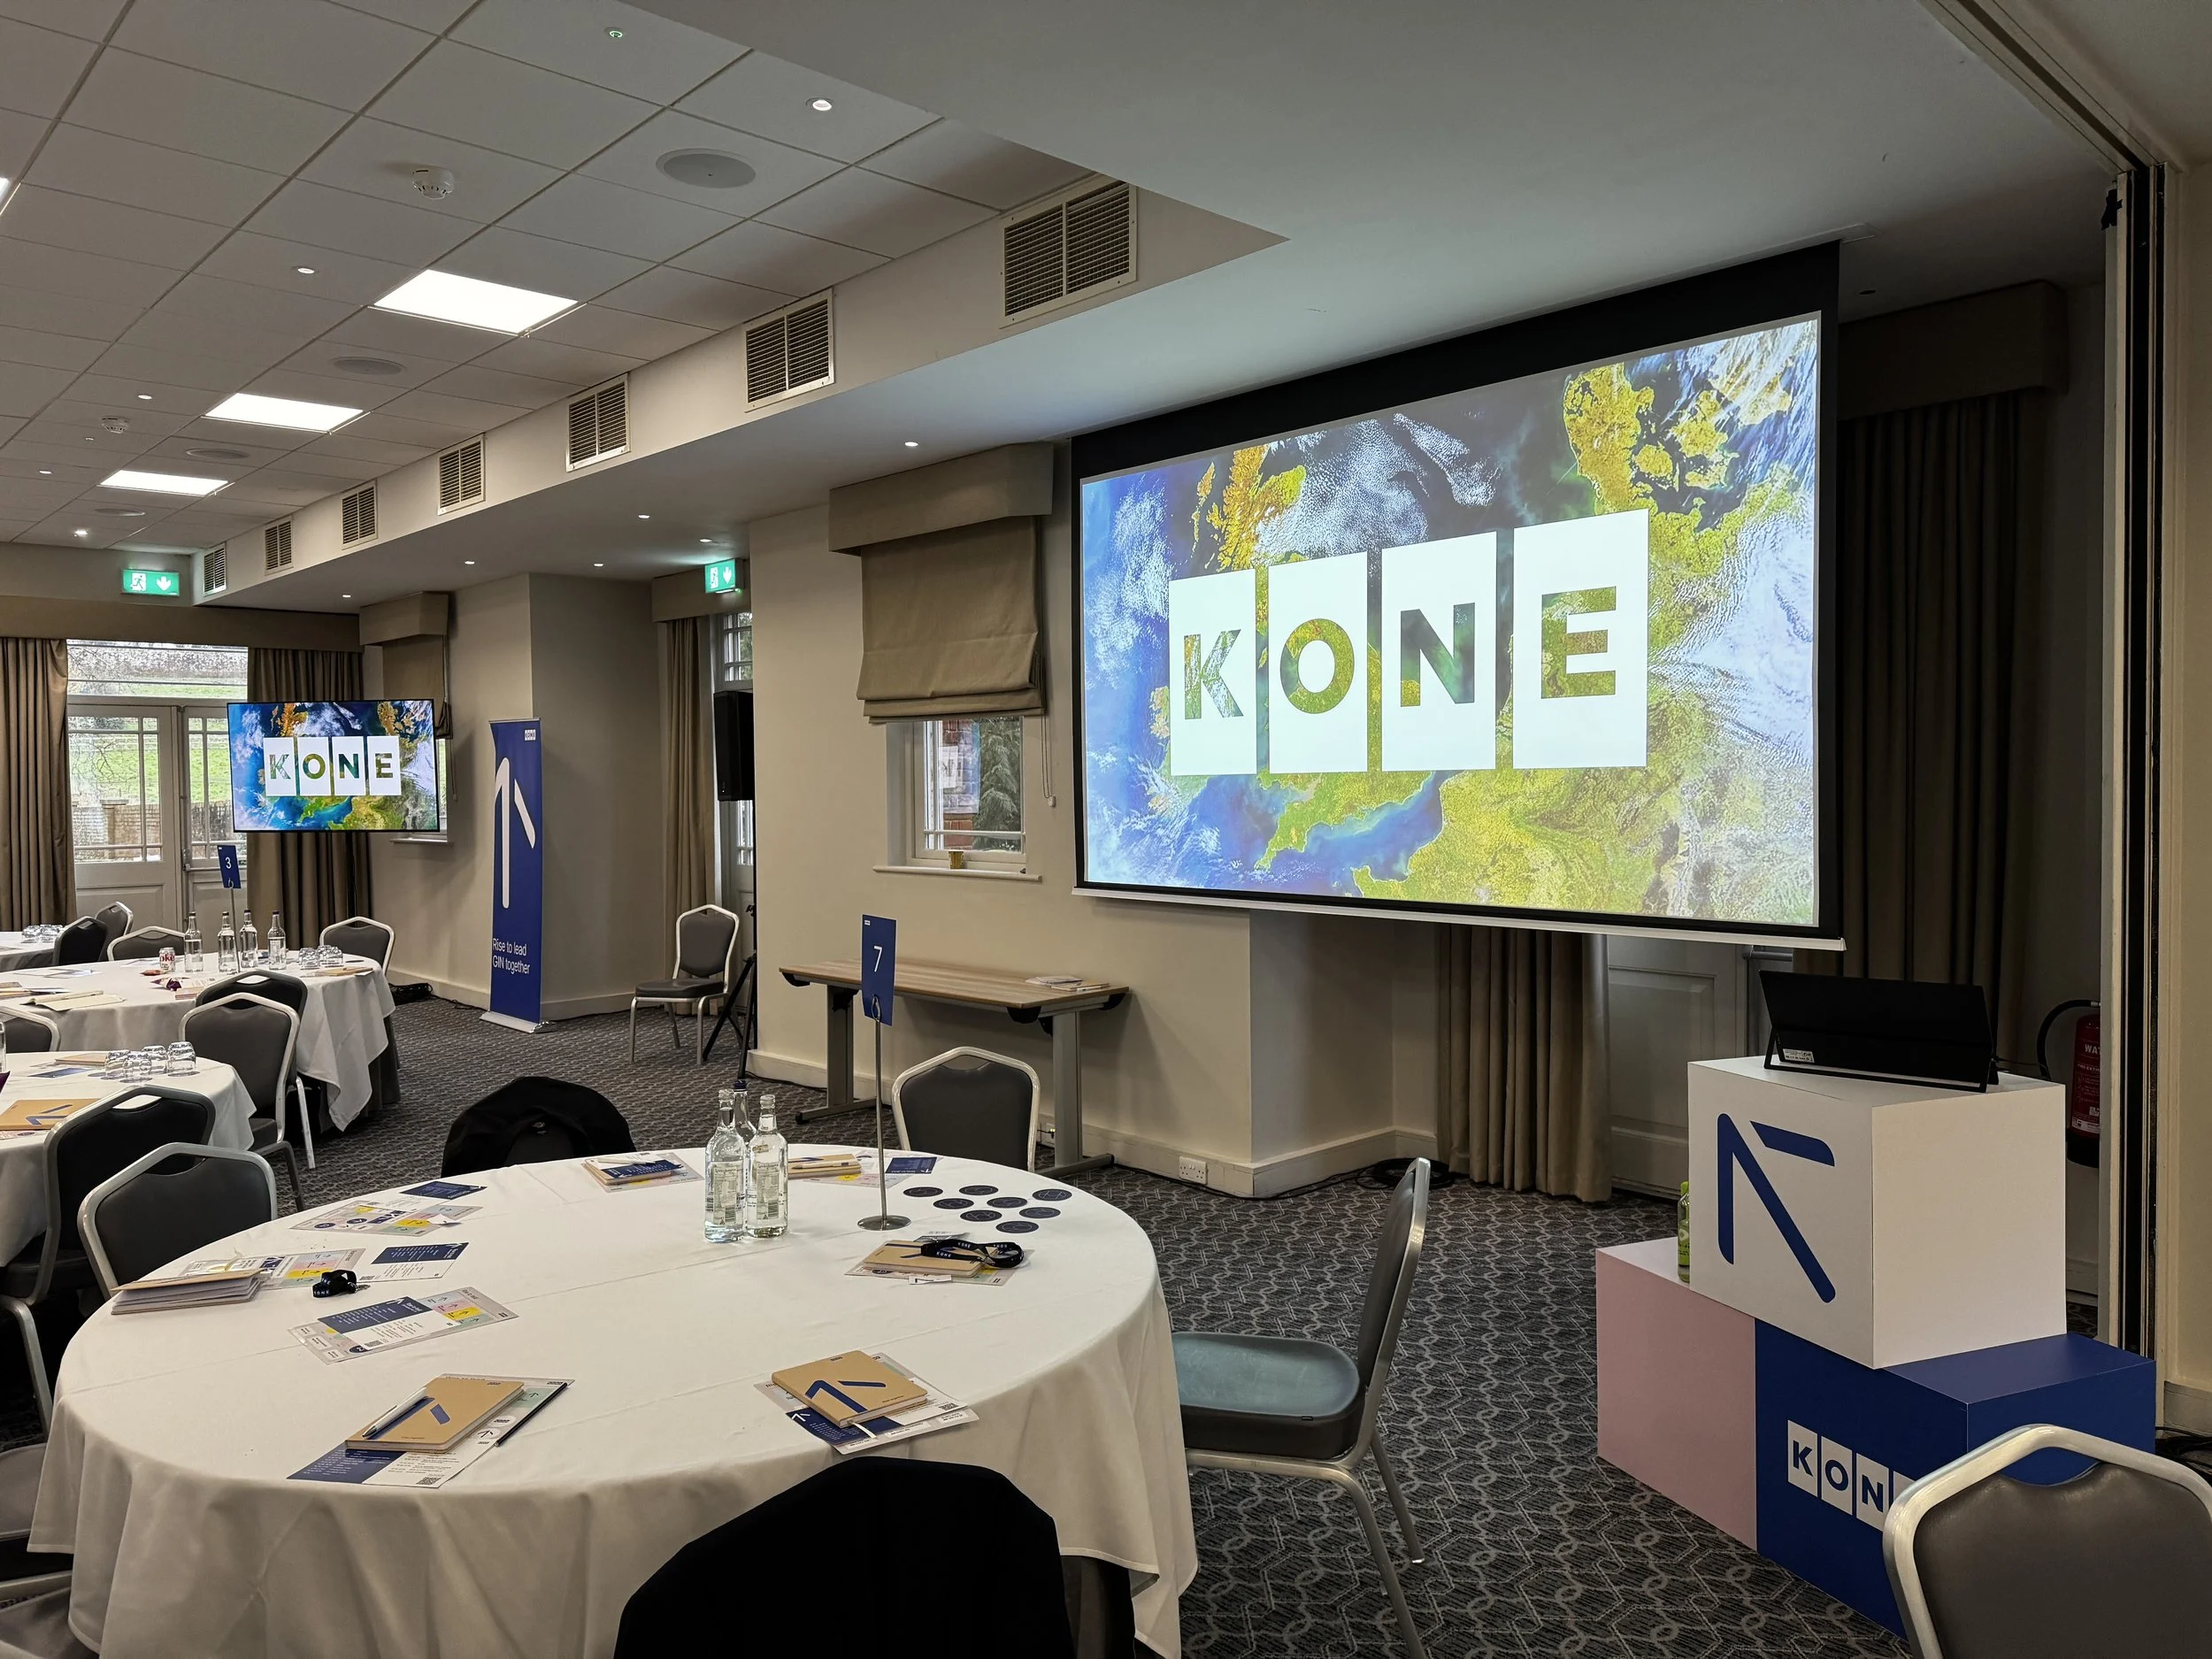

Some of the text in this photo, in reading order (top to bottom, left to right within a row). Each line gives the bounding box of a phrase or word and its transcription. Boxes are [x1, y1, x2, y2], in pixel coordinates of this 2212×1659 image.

[1183, 586, 1617, 720] KONE
[269, 753, 394, 780] KONE
[225, 856, 232, 870] 3
[492, 938, 527, 956] Rise to lead
[873, 945, 883, 972] 7
[492, 955, 530, 974] GIN together
[1793, 1440, 1884, 1513] KON
